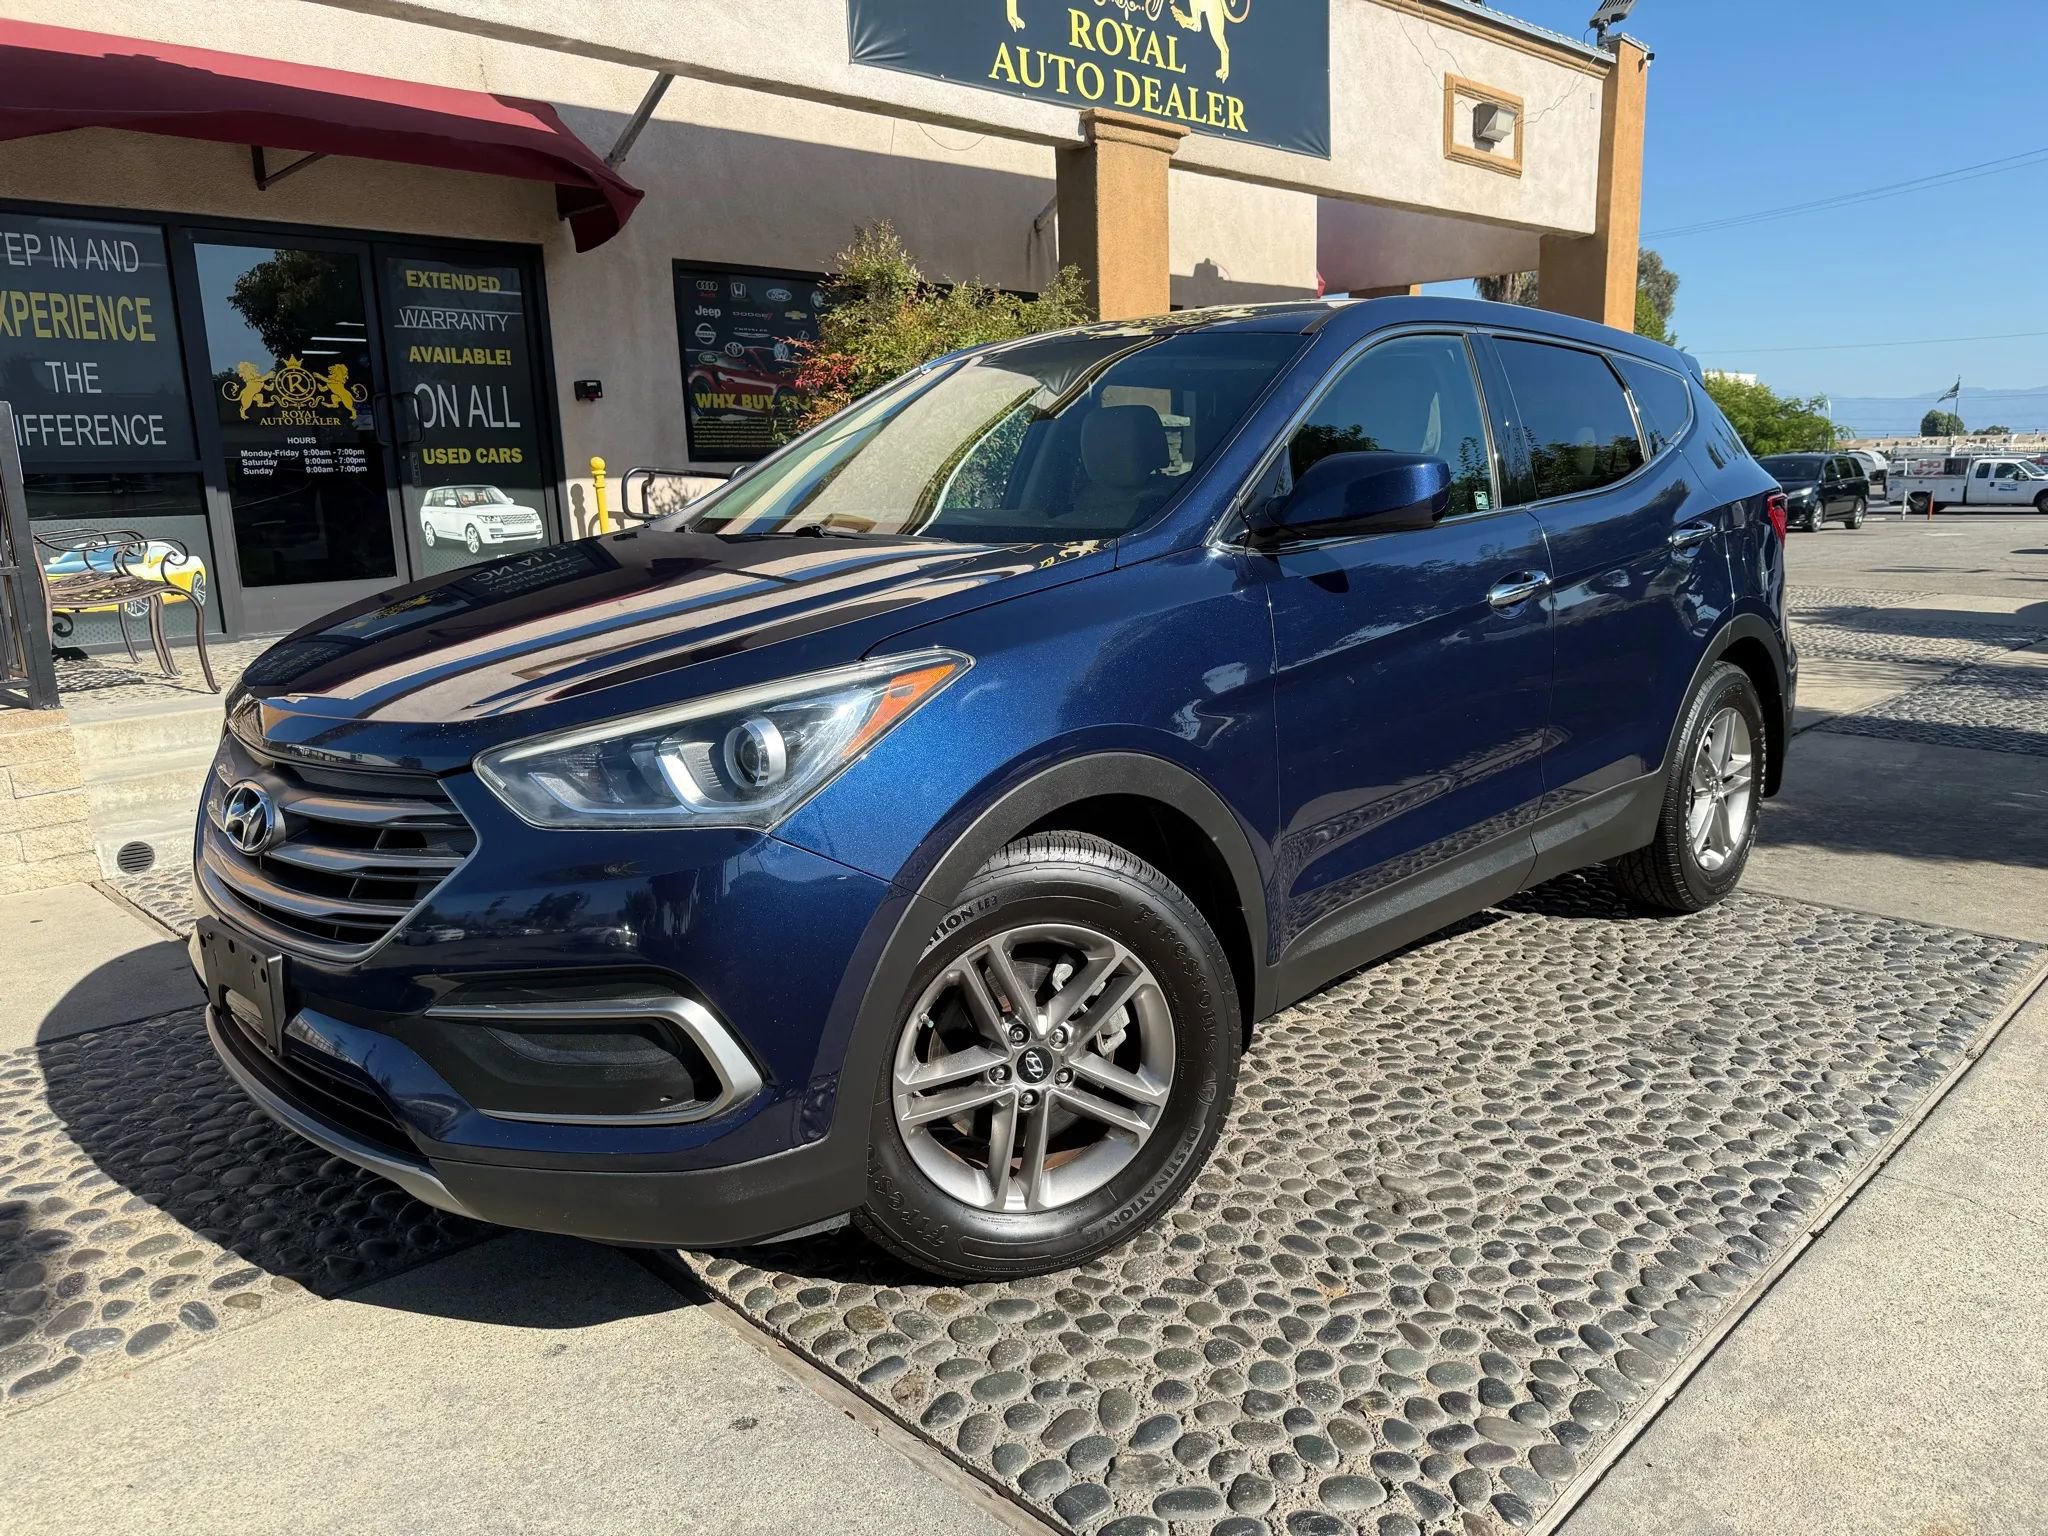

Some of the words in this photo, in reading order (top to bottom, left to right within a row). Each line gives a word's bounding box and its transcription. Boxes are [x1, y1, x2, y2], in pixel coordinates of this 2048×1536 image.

[1067, 8, 1187, 74] ROYAL
[988, 42, 1105, 101] AUTO
[1113, 68, 1249, 132] DEALER
[0, 231, 41, 266] EP
[50, 235, 78, 269] IN
[85, 238, 139, 272] AND
[405, 270, 501, 292] EXTENDED
[0, 290, 156, 342] XPERIENCE
[399, 308, 509, 332] WARRANTY
[695, 305, 721, 318] Jeep
[409, 345, 512, 366] AVAILABLE!
[44, 361, 102, 393] THE
[413, 383, 460, 428] ON
[468, 385, 521, 428] ALL
[695, 393, 736, 409] WHY
[741, 394, 774, 410] BUY
[260, 417, 295, 426] AUTO
[296, 417, 342, 426] DEALER
[281, 410, 320, 419] ROYAL
[15, 414, 167, 446] IFFERENCE
[240, 450, 300, 458] Monday-Friday
[337, 449, 365, 457] 7:00pm
[242, 459, 278, 467] Saturday
[339, 457, 366, 465] 7:00pm
[422, 448, 471, 464] USED
[476, 447, 523, 463] CARS
[243, 468, 274, 476] Sunday
[306, 466, 334, 474] 9:00am
[340, 466, 367, 474] 7:00pm
[924, 906, 975, 946] TION
[978, 895, 998, 911] LE3
[1107, 1126, 1200, 1230] DESTINATION
